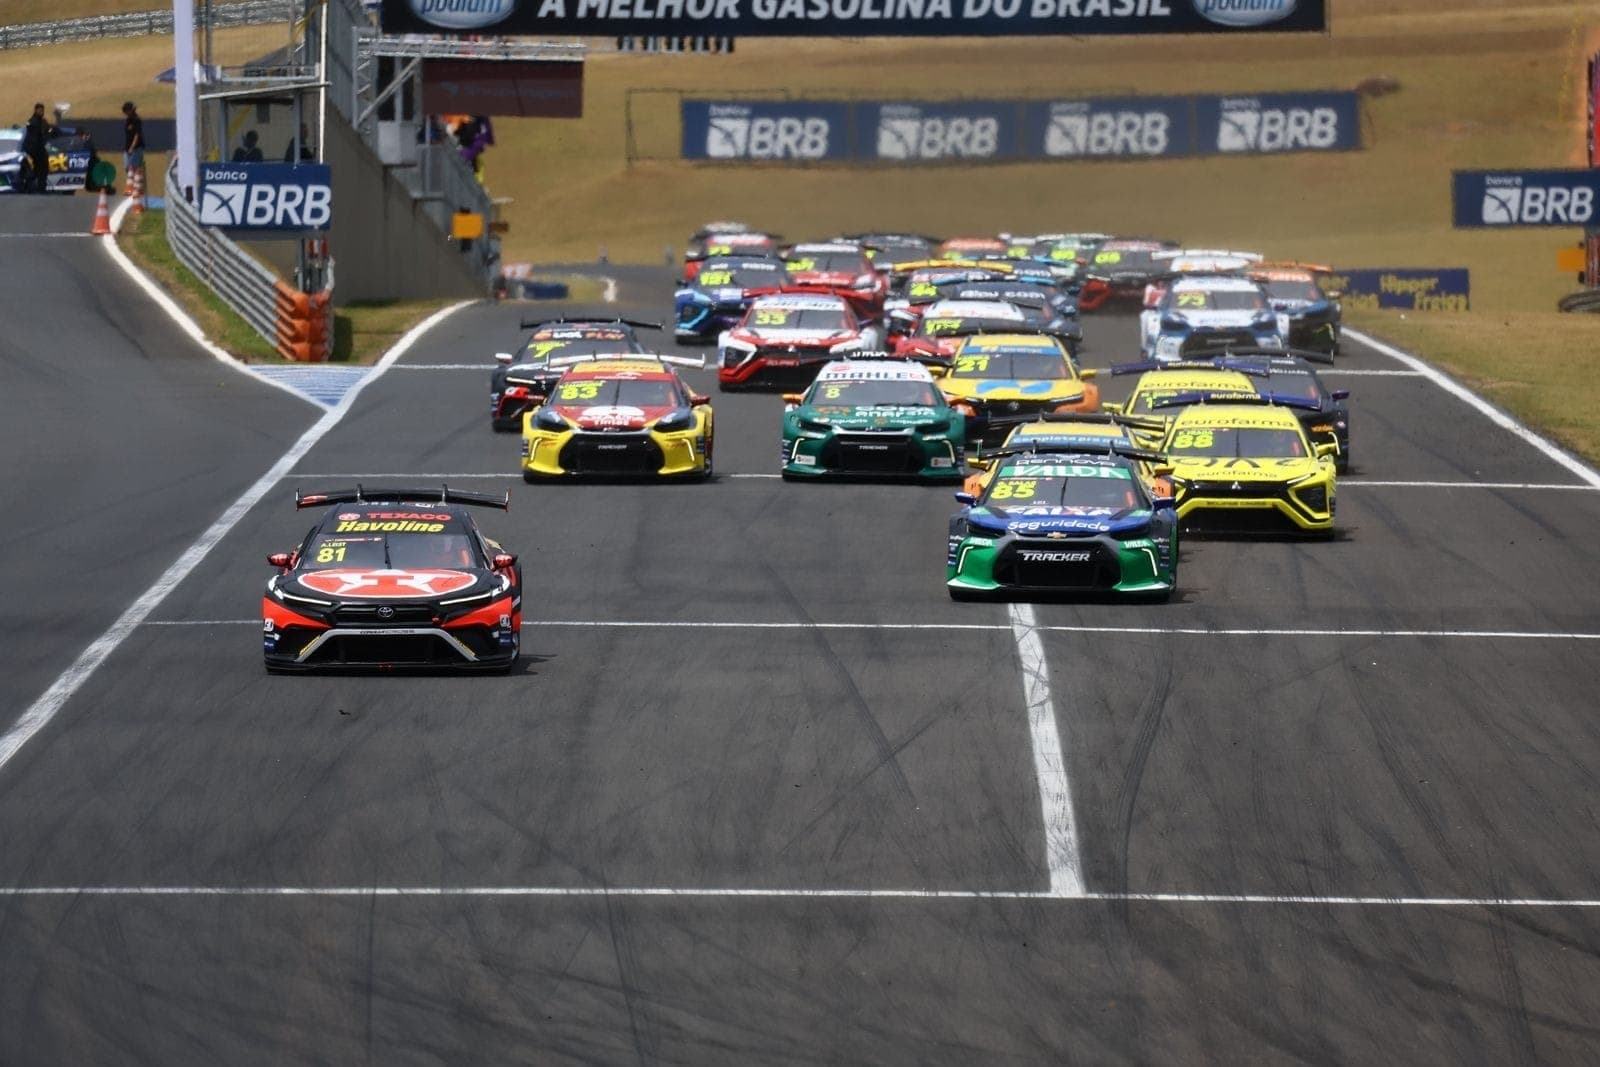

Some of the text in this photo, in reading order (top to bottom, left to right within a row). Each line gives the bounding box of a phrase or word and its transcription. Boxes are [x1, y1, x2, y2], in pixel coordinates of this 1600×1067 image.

[537, 0, 1171, 20] A MELHOR GASOLINA DO BRASIL
[1088, 111, 1170, 155] BRB
[1260, 107, 1338, 151] BRB
[751, 117, 829, 159] BRB
[920, 117, 998, 159] BRB
[205, 168, 248, 182] banco
[1485, 175, 1523, 187] banco
[246, 184, 332, 226] BRB
[1521, 186, 1594, 222] BRB
[956, 357, 989, 372] 21
[826, 388, 841, 399] 8
[1210, 392, 1261, 400] eurofarma
[1180, 418, 1295, 428] eurofarma
[1173, 434, 1213, 448] 88
[990, 485, 1035, 499] 85
[367, 512, 452, 521] TEXACO
[336, 521, 445, 533] Havoline
[1007, 520, 1110, 532] Seguridade
[317, 547, 346, 563] 81
[1022, 552, 1091, 562] TRACKER
